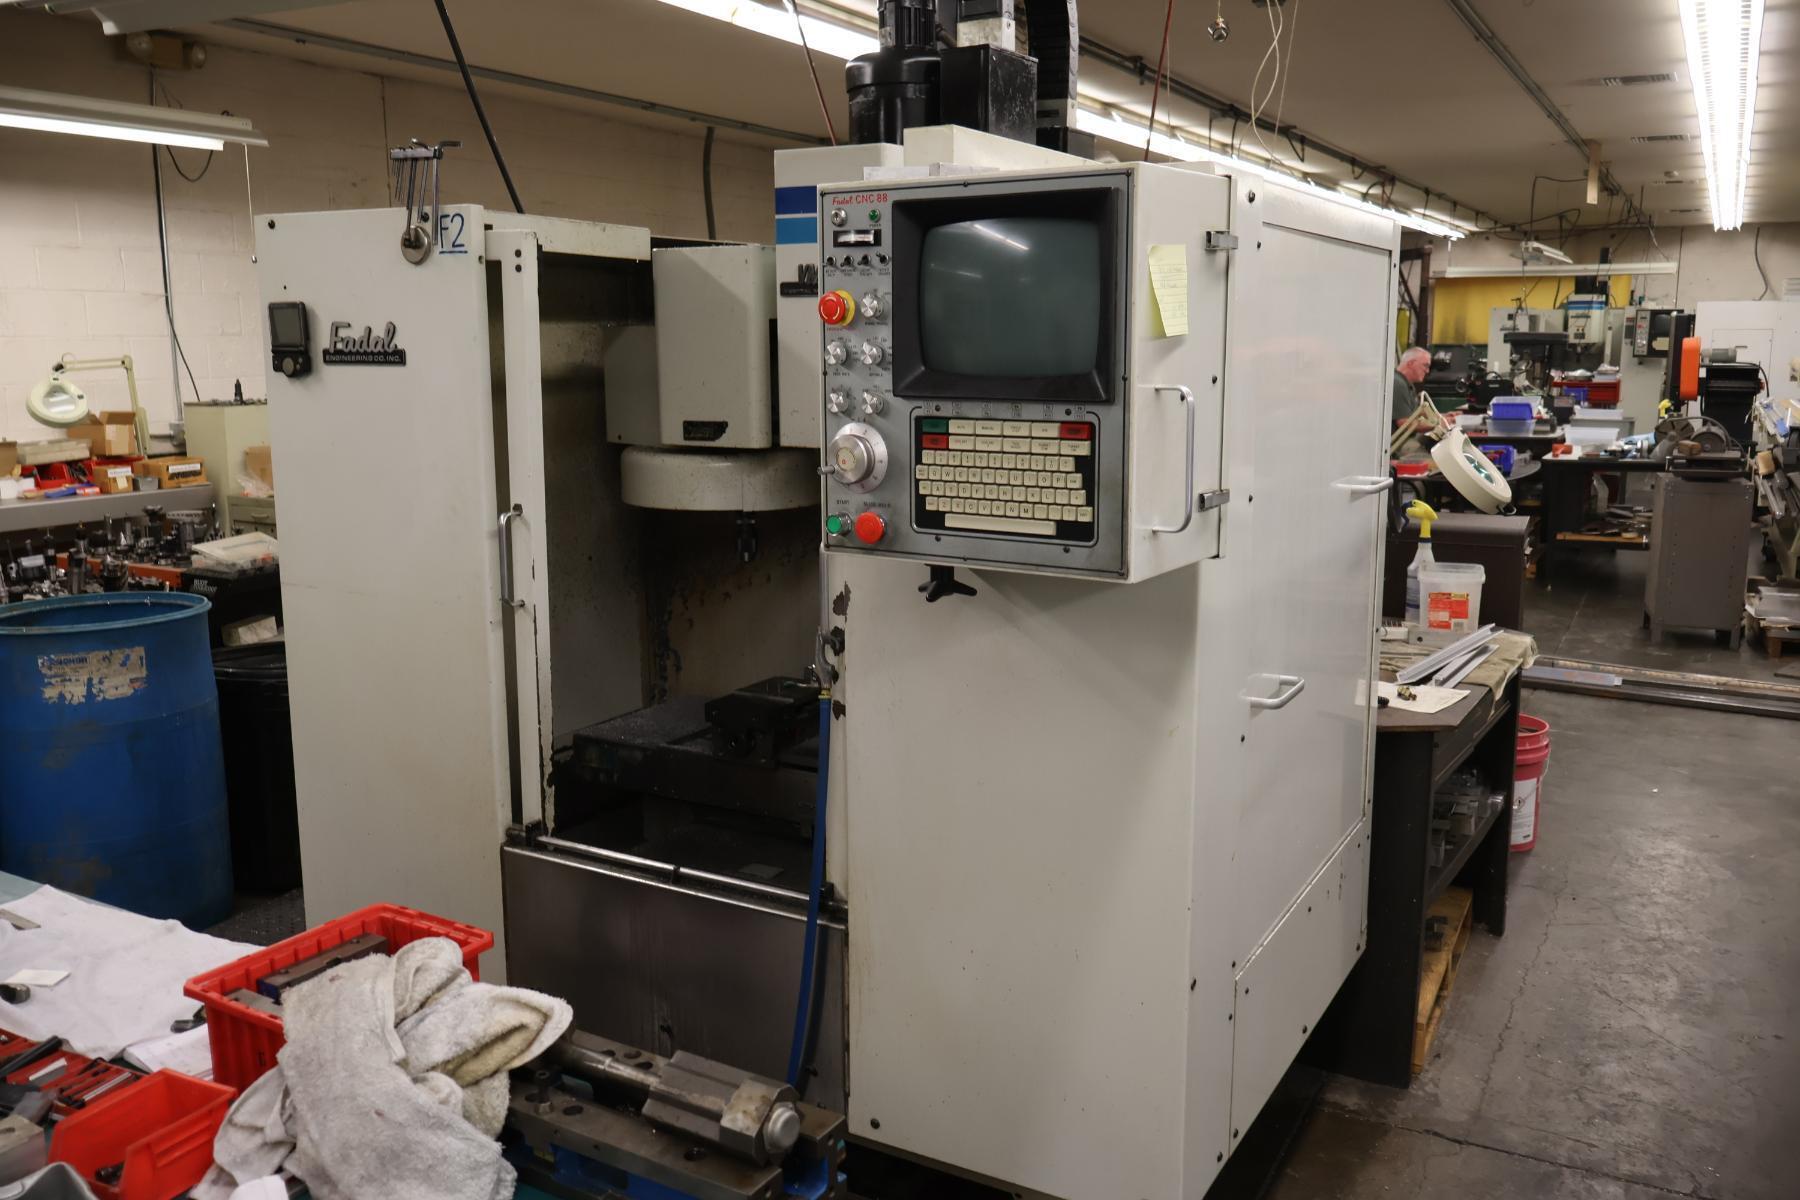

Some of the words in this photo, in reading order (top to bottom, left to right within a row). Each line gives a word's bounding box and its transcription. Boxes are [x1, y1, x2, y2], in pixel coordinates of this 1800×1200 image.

[855, 194, 875, 204] CNC
[876, 192, 888, 203] 88
[440, 213, 465, 249] F2
[329, 321, 397, 353] Fadal
[325, 354, 373, 362] ENGINEERING
